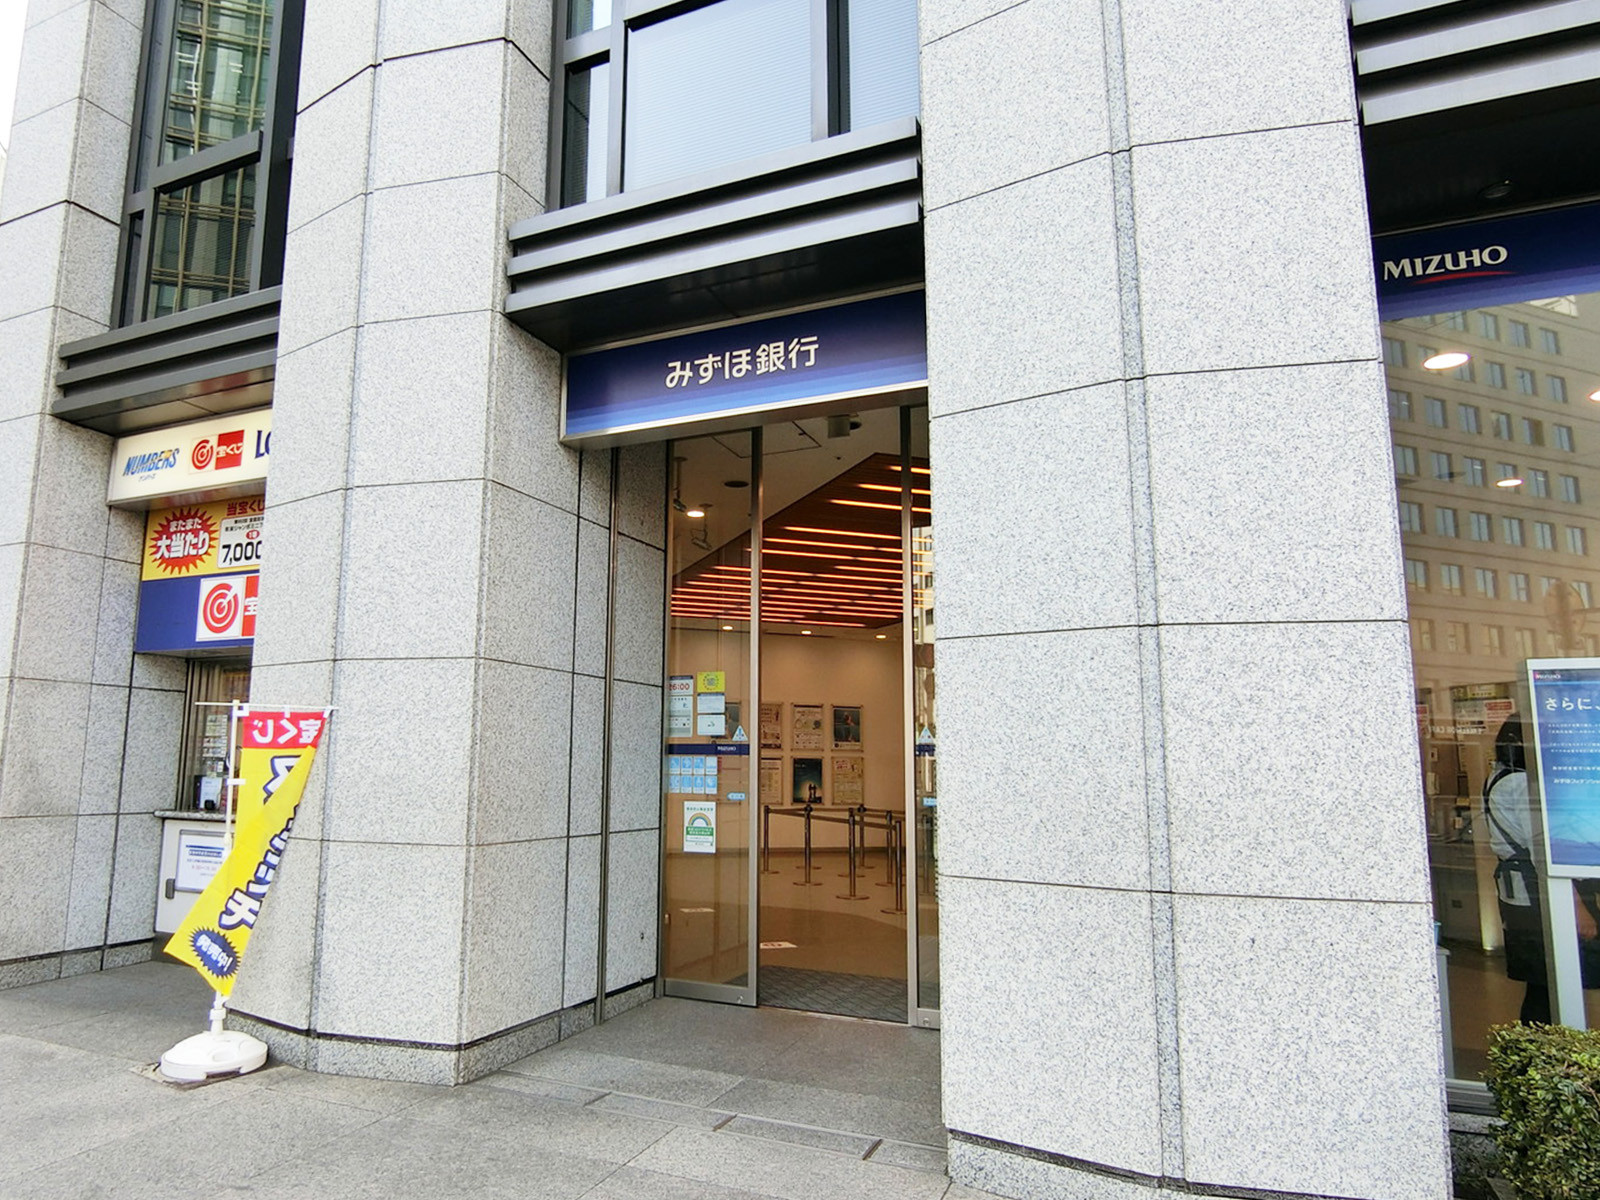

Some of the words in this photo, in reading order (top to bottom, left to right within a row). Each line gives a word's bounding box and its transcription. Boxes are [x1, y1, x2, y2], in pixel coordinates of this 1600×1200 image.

[1383, 245, 1508, 281] MIZUHO
[665, 336, 819, 388] みずほ銀行
[122, 447, 180, 476] NUMBERS
[169, 518, 202, 532] またまた
[155, 531, 210, 560] 大当たり
